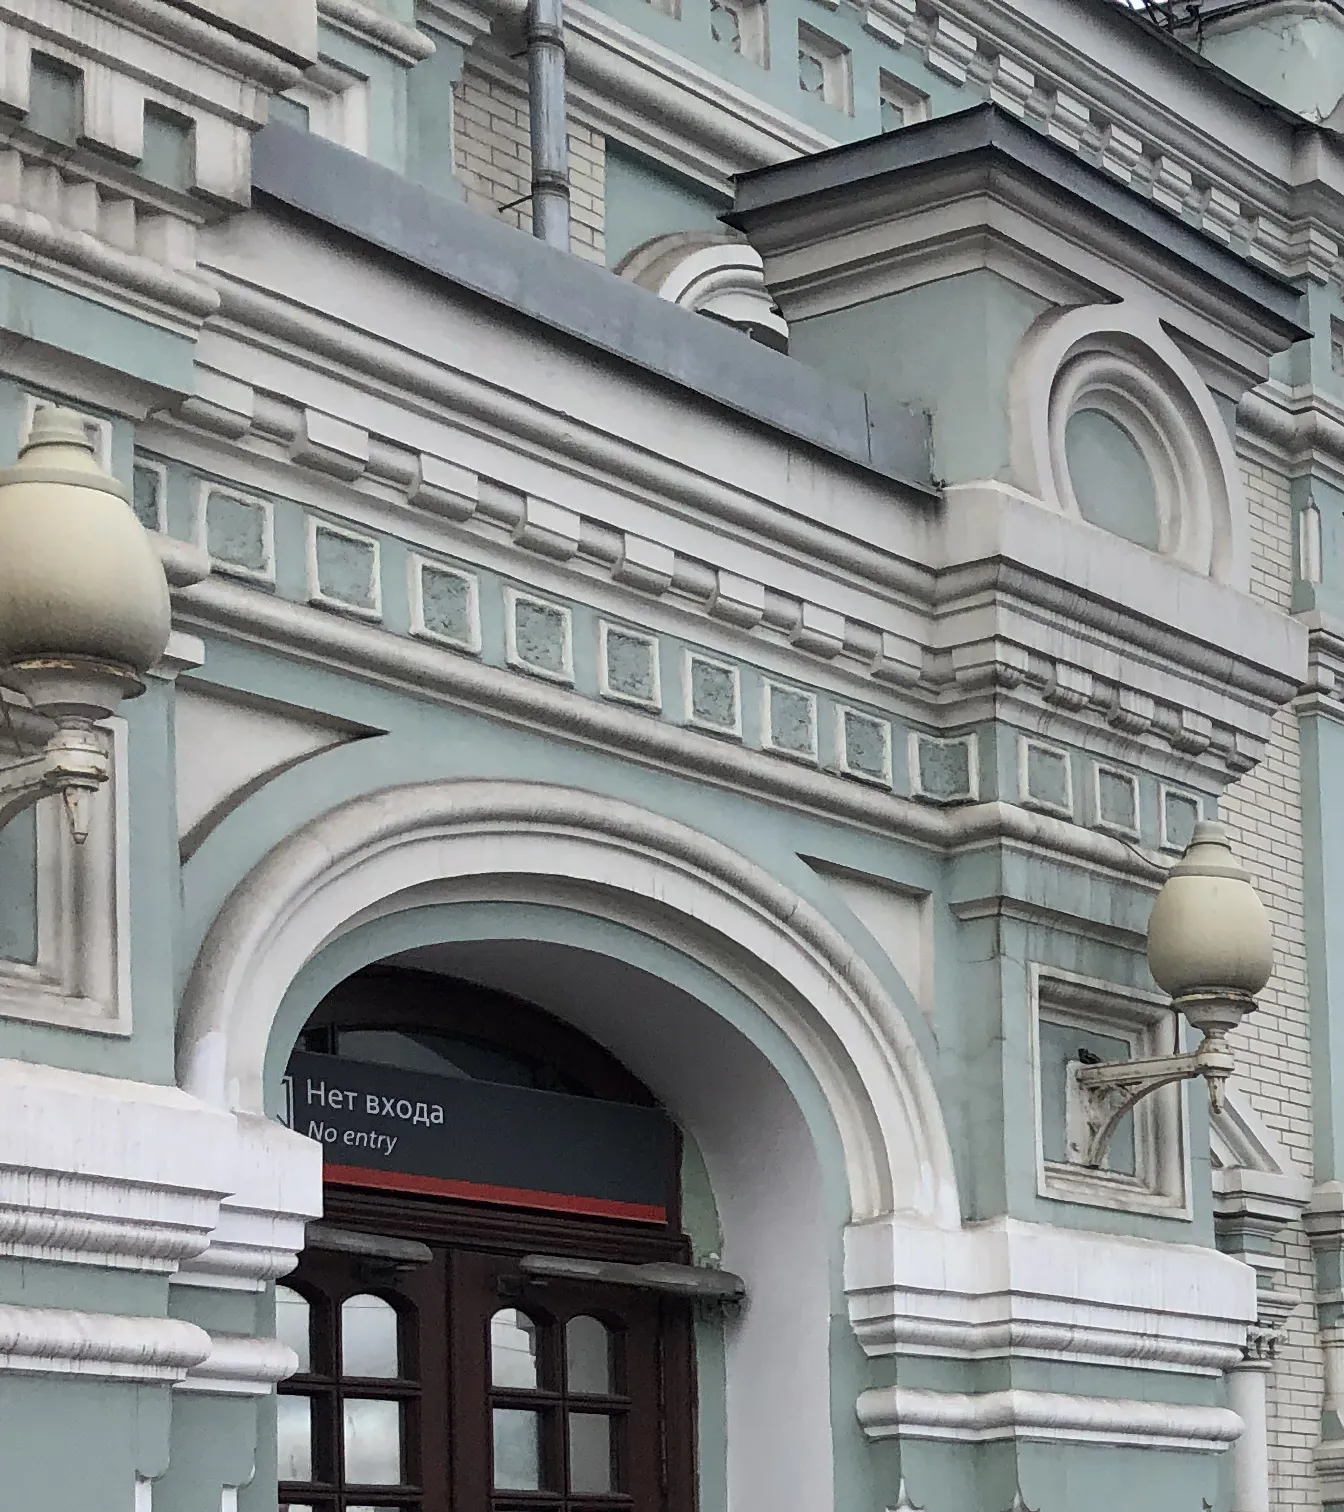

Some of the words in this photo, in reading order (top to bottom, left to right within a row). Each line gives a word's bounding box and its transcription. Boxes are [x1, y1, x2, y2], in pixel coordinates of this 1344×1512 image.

[307, 1078, 358, 1111] Нет
[366, 1094, 444, 1127] входа
[308, 1120, 338, 1143] No
[343, 1130, 398, 1156] entry
